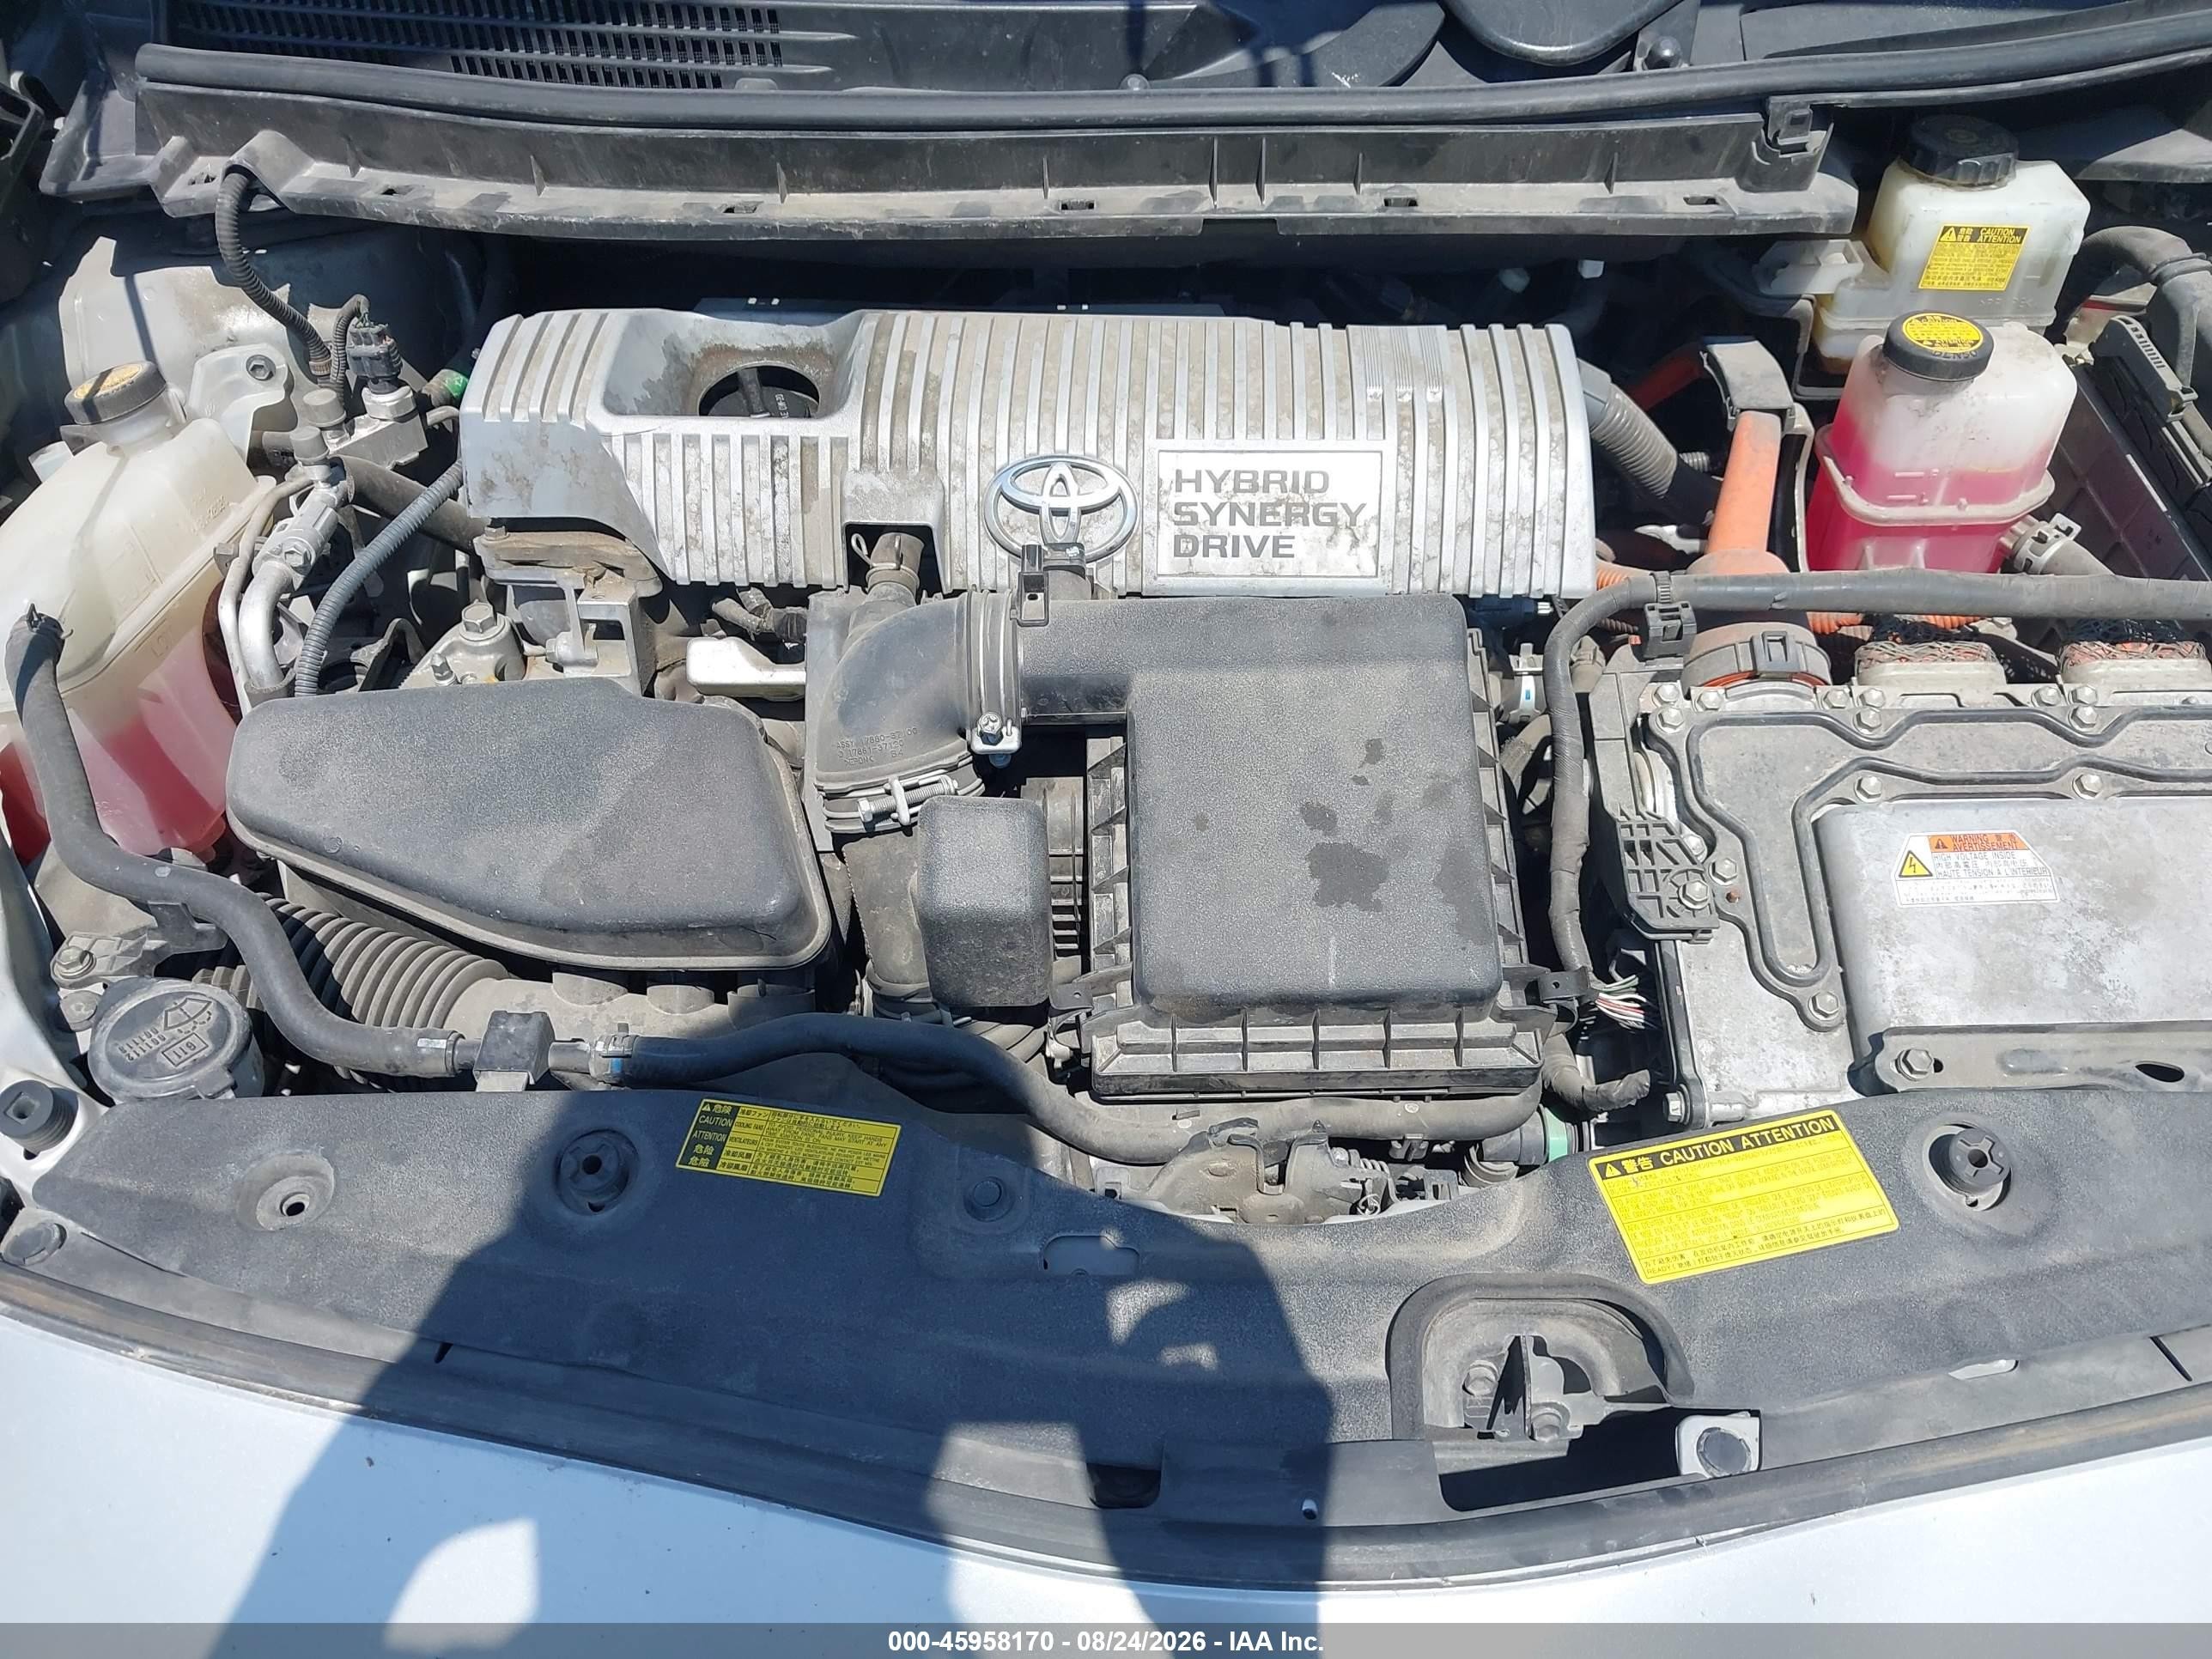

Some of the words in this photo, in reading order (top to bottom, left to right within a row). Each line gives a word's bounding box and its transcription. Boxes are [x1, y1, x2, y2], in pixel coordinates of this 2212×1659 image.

[1932, 349, 1978, 360] DENSO
[1175, 469, 1329, 494] HYBRID
[1173, 501, 1367, 527] SYNERGY
[1173, 534, 1295, 558] DRIVE
[1950, 834, 1989, 843] WARNING
[1953, 842, 2018, 851] AVERTISSEMENT
[1991, 851, 2016, 860] INSIDE
[698, 1115, 733, 1127] CAUTION
[691, 1130, 727, 1142] ATTENTION
[1621, 1155, 1655, 1171] 警告
[1660, 1138, 1735, 1166] CAUTION
[1742, 1117, 1836, 1150] ATTENTION
